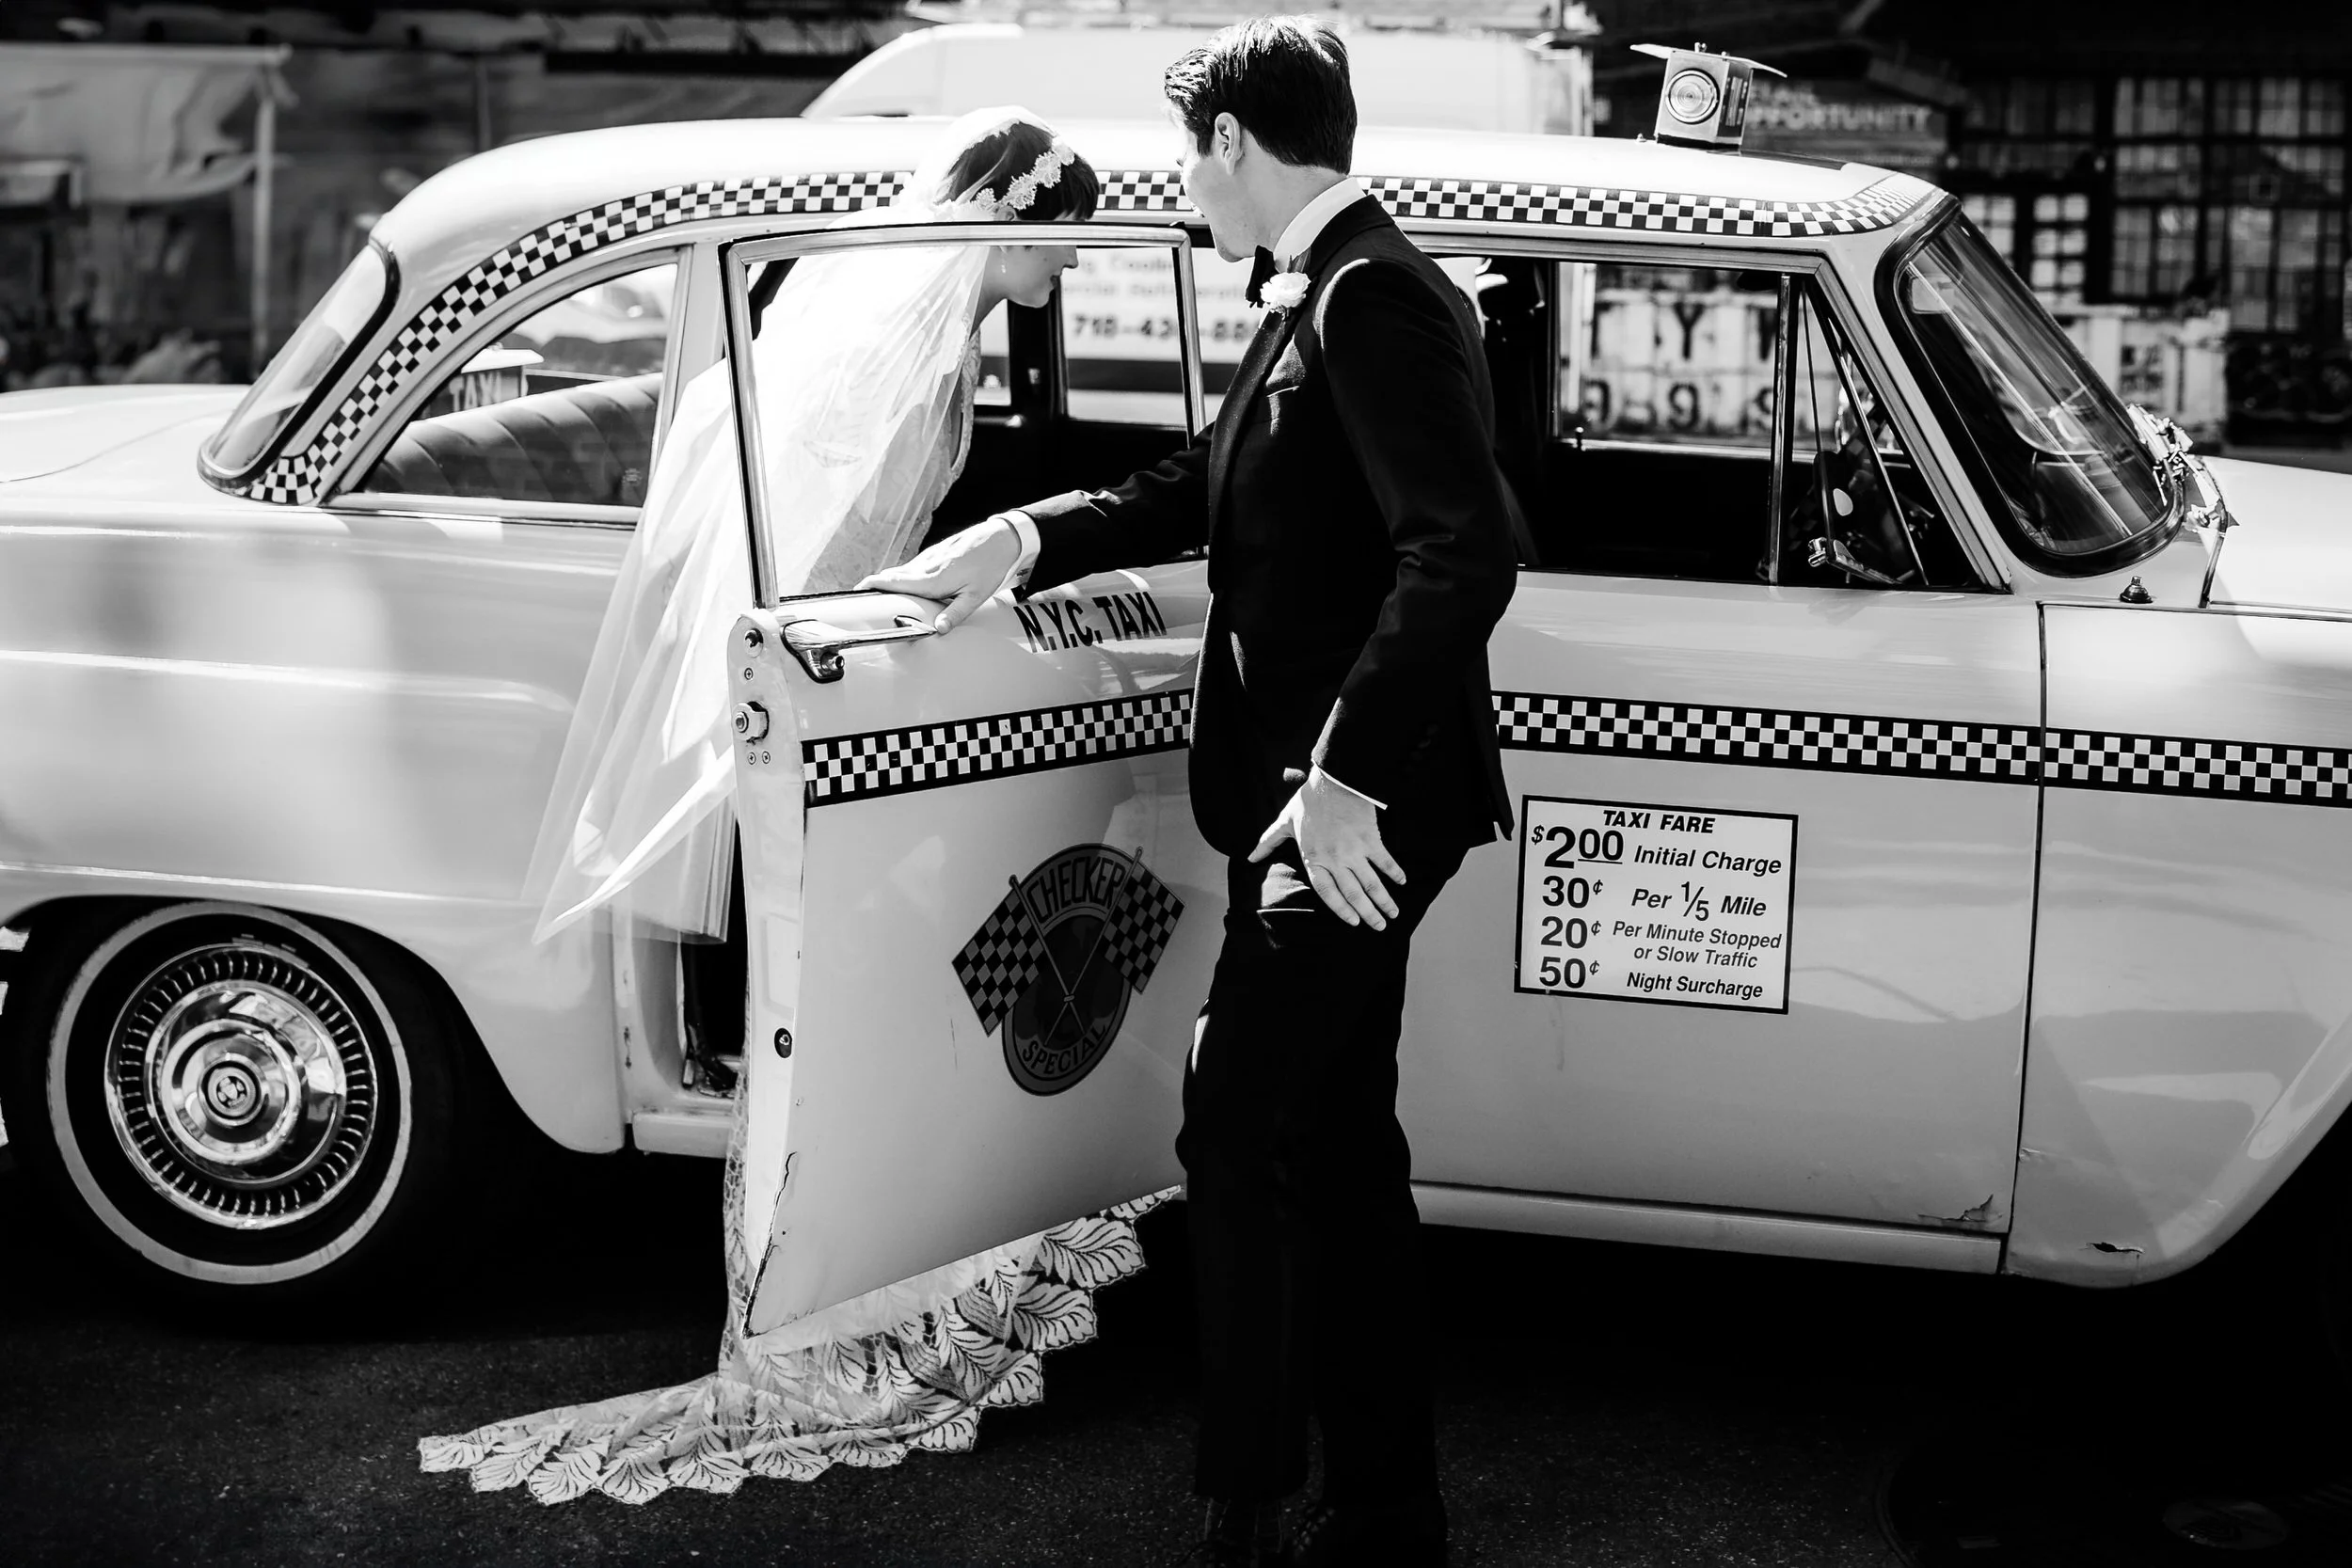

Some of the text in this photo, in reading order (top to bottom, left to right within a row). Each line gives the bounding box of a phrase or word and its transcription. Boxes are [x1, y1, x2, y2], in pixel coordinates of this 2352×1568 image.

[449, 370, 502, 412] TAXI
[1012, 591, 1168, 653] N.Y.C. TAXI
[1603, 810, 1715, 834] TAXI FARE
[1634, 846, 1696, 867] Initial
[1702, 850, 1782, 877] Charge
[1026, 856, 1126, 924] CHECKER
[1542, 875, 1603, 909] 30¢
[1630, 888, 1672, 910] Per
[1720, 895, 1767, 916] Mile
[1540, 916, 1782, 950] 20¢ Per Minute Stopped
[1633, 945, 1758, 968] or Slow Traffic
[1538, 957, 1763, 999] 50¢ Night Surcharge
[1022, 1024, 1106, 1075] SPECIAL
